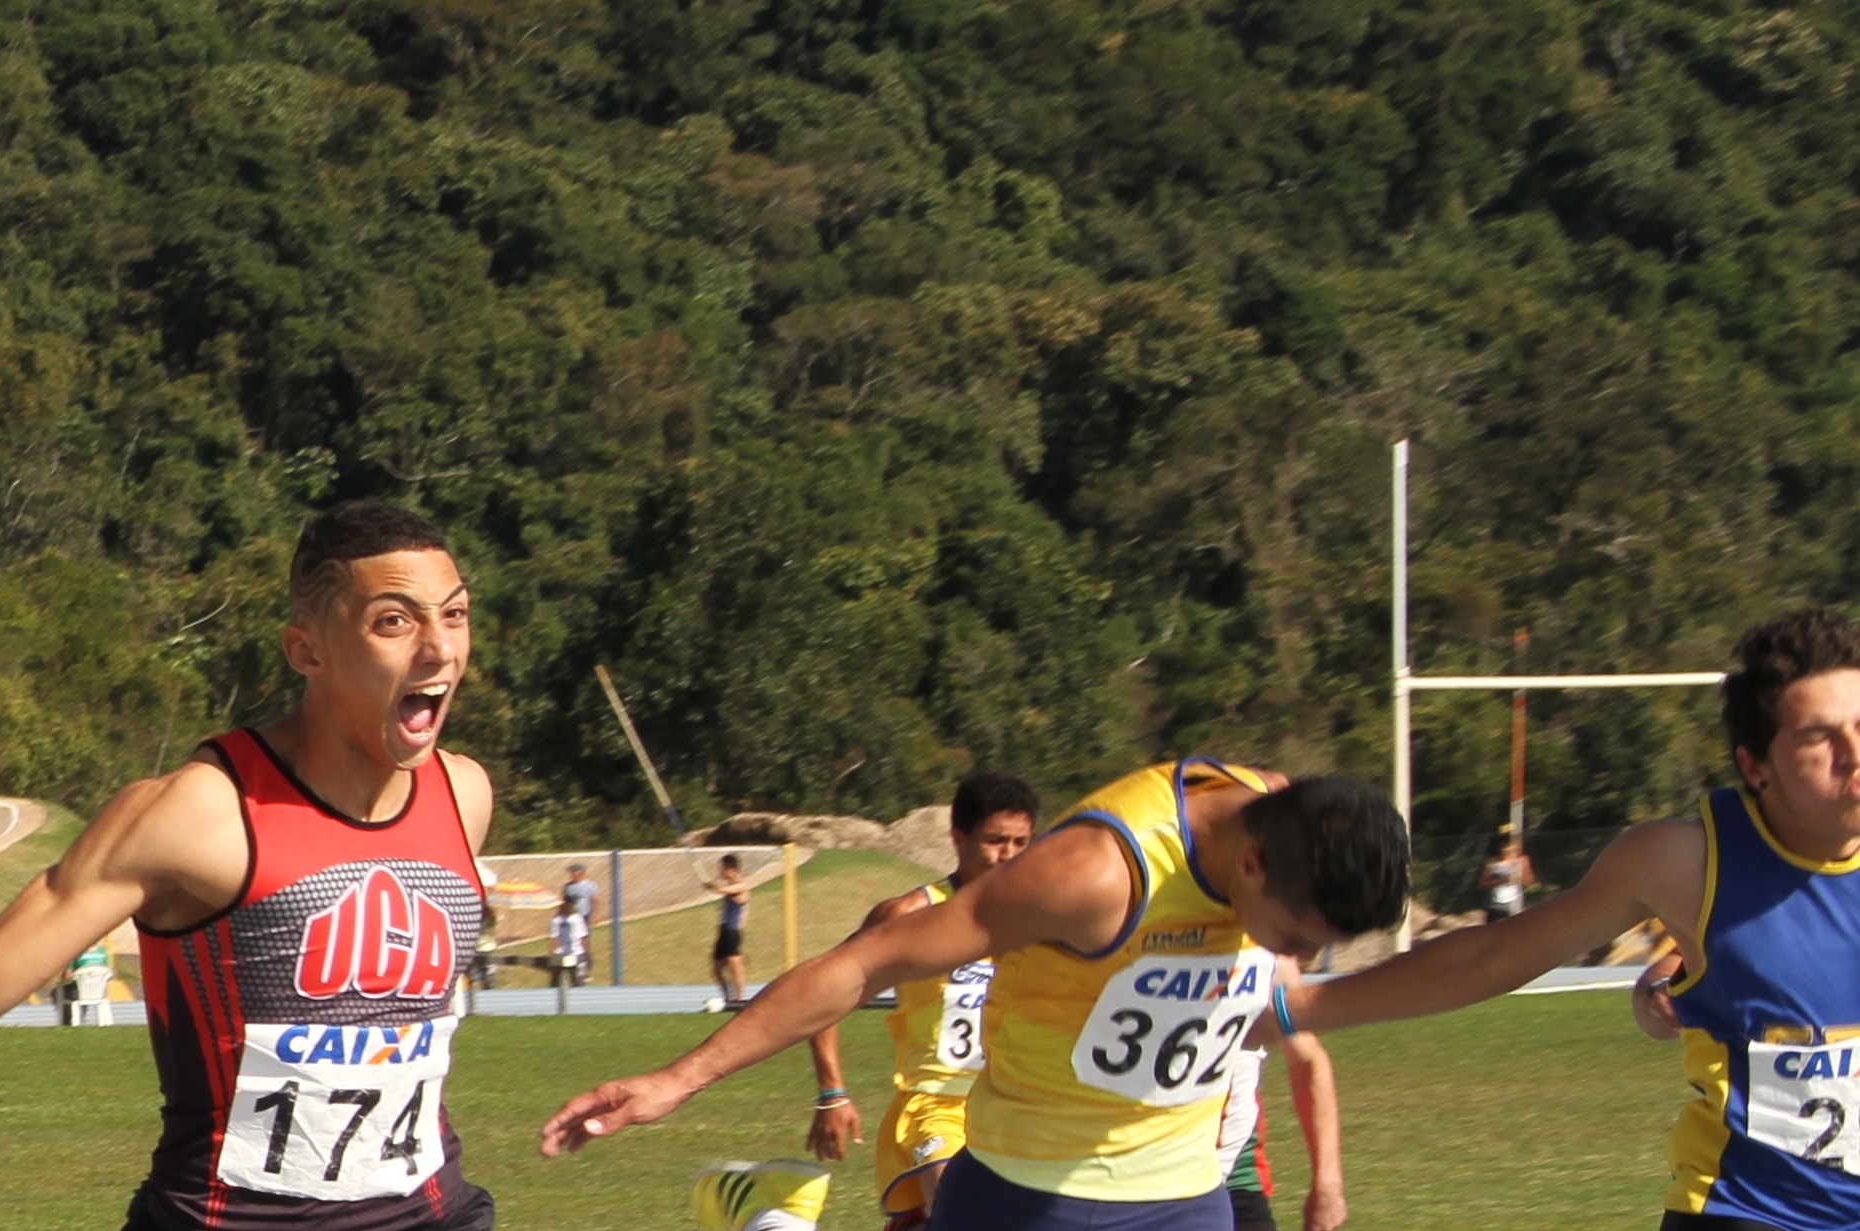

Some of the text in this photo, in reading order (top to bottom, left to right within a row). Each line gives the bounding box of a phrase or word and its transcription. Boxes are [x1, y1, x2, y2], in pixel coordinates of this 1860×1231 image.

[1134, 964, 1258, 1001] CAIXA
[276, 1020, 434, 1065] CAIXA
[1090, 1007, 1247, 1091] 362
[1774, 1048, 1860, 1080] CAI
[253, 1079, 427, 1182] 174
